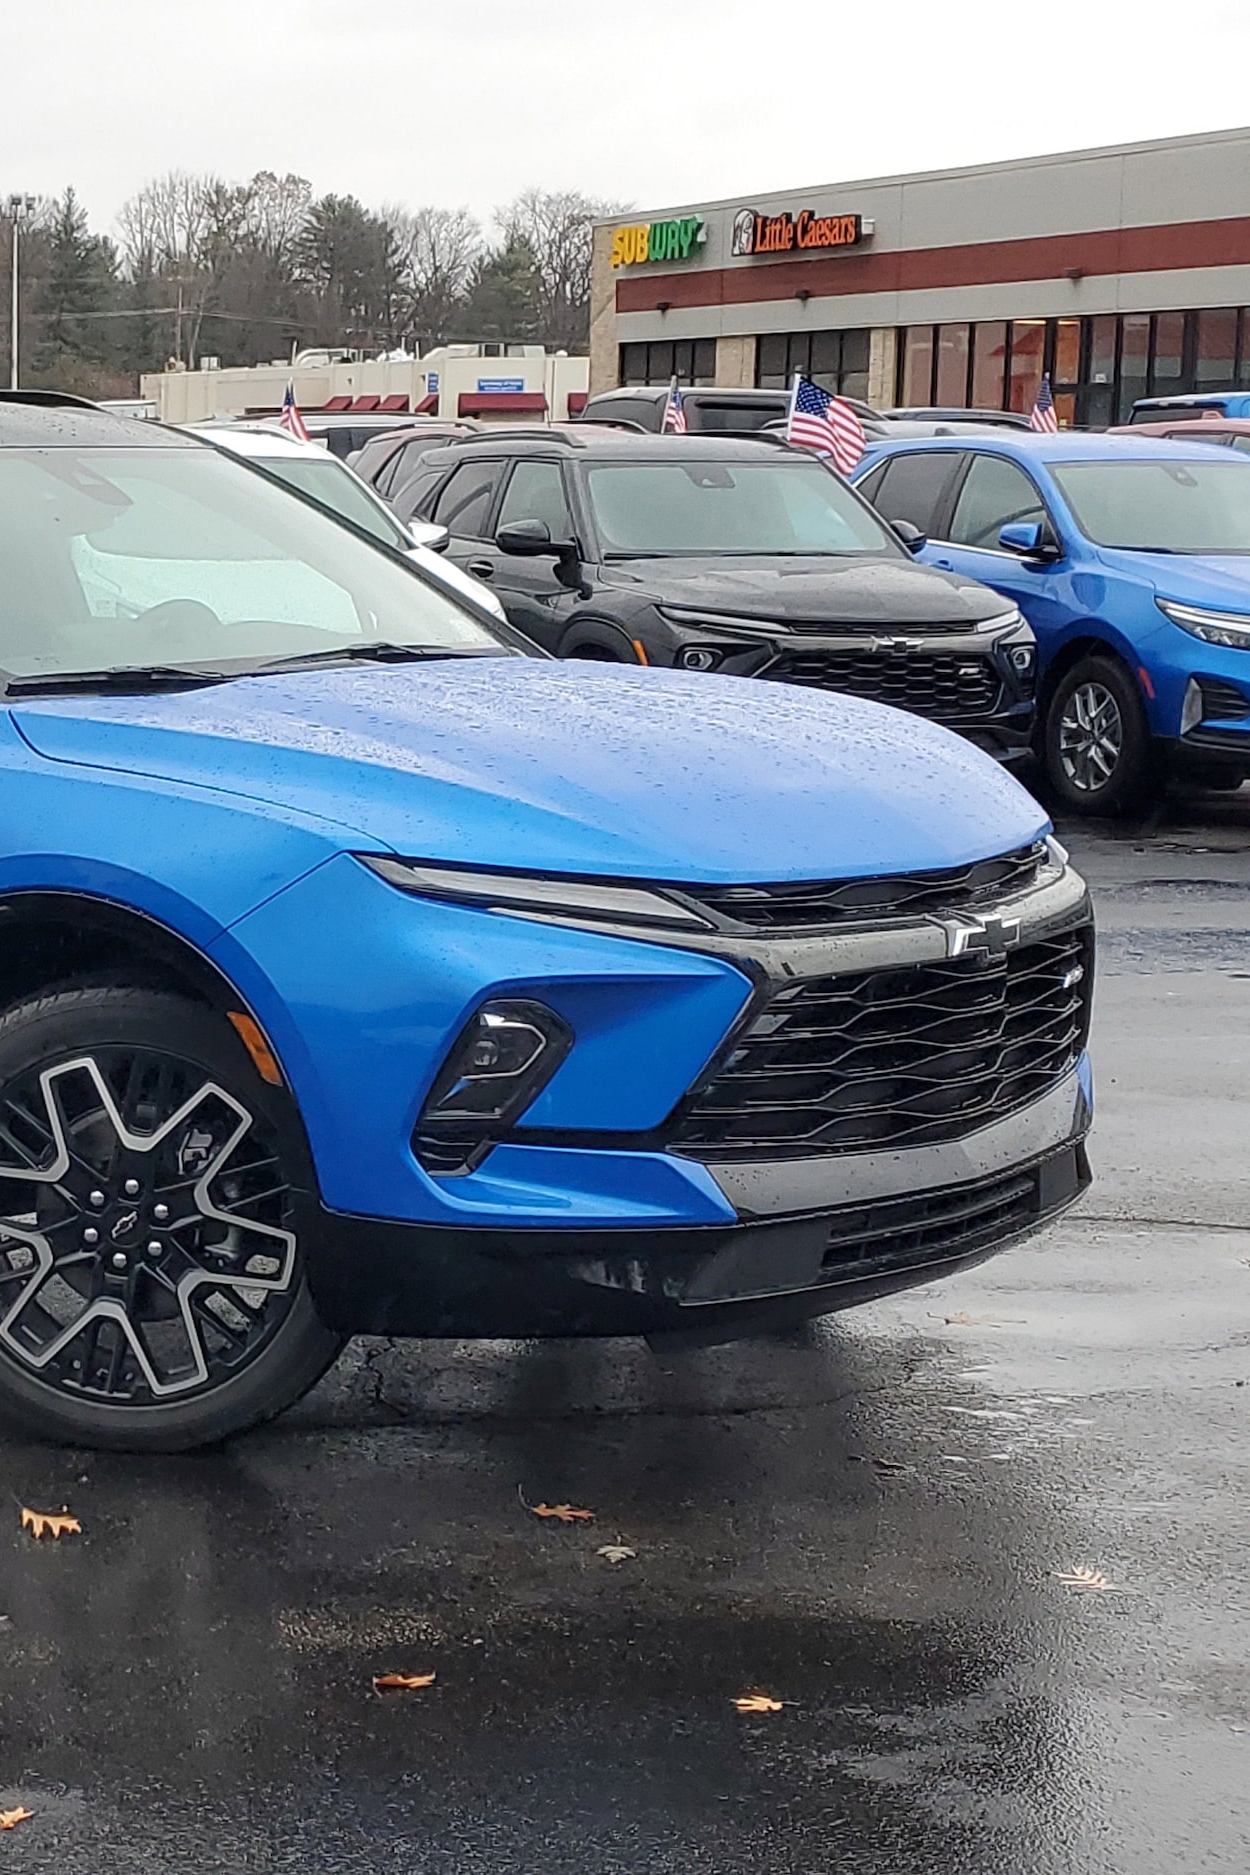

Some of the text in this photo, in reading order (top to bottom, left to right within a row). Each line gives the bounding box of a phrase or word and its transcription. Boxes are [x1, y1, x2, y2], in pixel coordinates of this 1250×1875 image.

[610, 216, 706, 268] SUBWAY
[754, 209, 856, 252] Little Caesars
